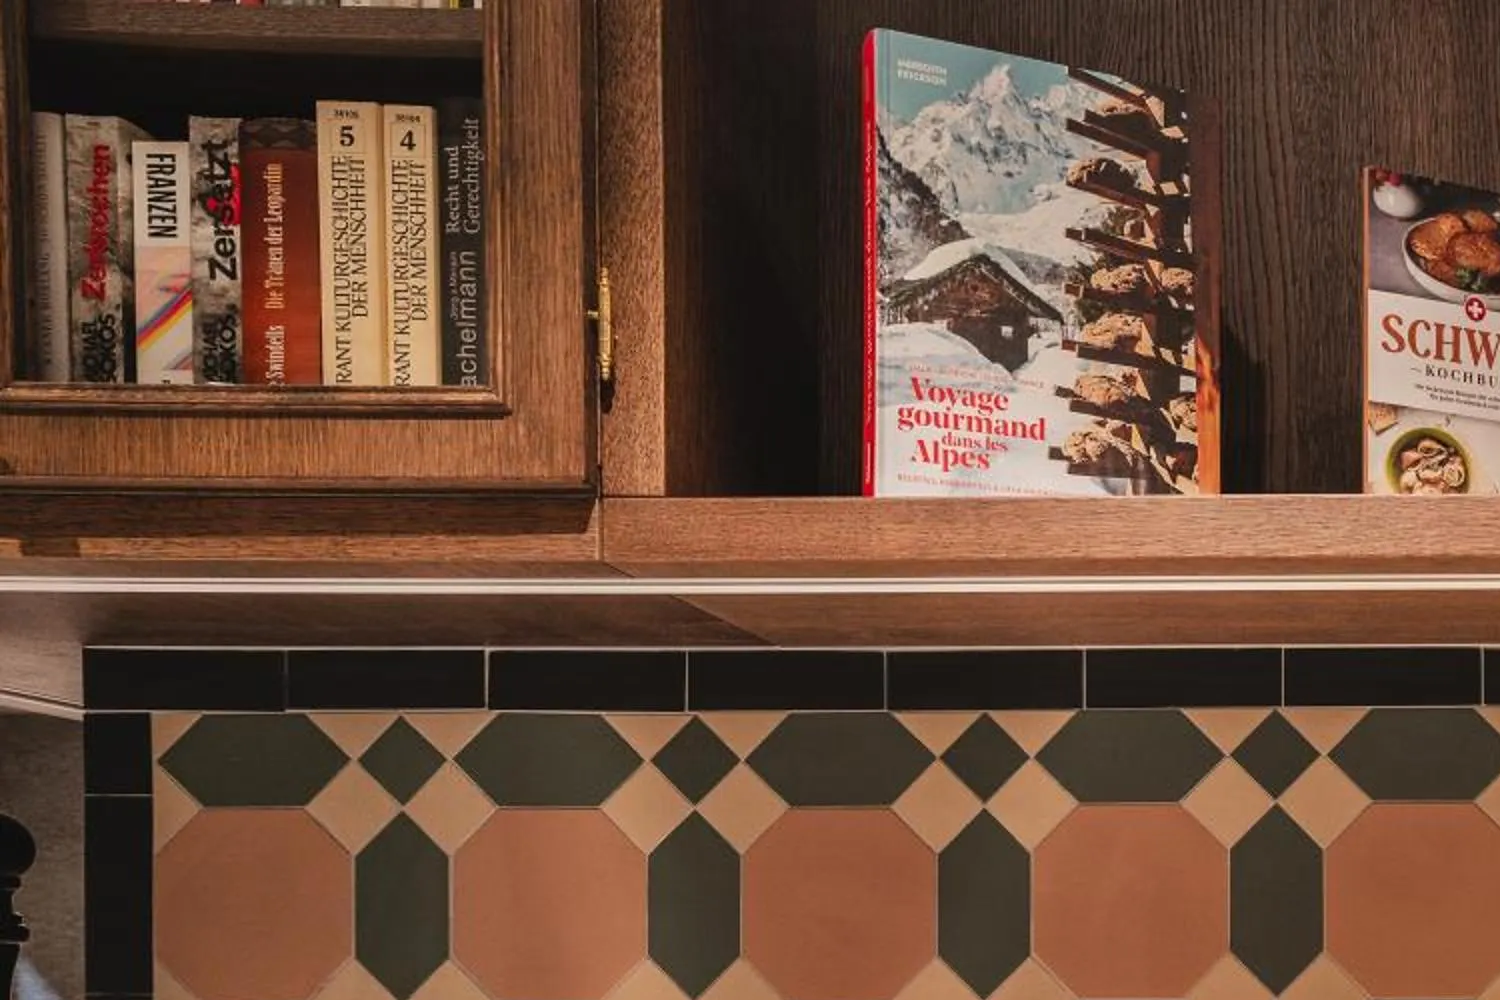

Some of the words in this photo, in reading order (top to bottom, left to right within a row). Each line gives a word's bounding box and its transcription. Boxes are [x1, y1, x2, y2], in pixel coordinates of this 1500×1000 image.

[339, 125, 355, 147] 5
[400, 130, 416, 151] 4
[444, 146, 459, 178] und
[462, 118, 484, 234] Gerechtigkeit
[146, 153, 178, 238] FRANZEN
[264, 163, 286, 223] Leopardin
[444, 185, 459, 234] Recht
[349, 157, 368, 275] MENSCHHEIT
[409, 161, 427, 278] MENSCHHEIT
[264, 225, 284, 245] der
[331, 156, 351, 332] KULTURGESCHICHTE
[391, 160, 410, 335] KULTURGESCHICHTE
[264, 290, 284, 309] Die
[351, 281, 368, 318] DER
[411, 284, 428, 321] DER
[911, 376, 1009, 416] Voyage
[897, 405, 1046, 441] gourmand
[911, 439, 990, 473] Alpes
[942, 432, 981, 450] dans
[986, 435, 1008, 452] les
